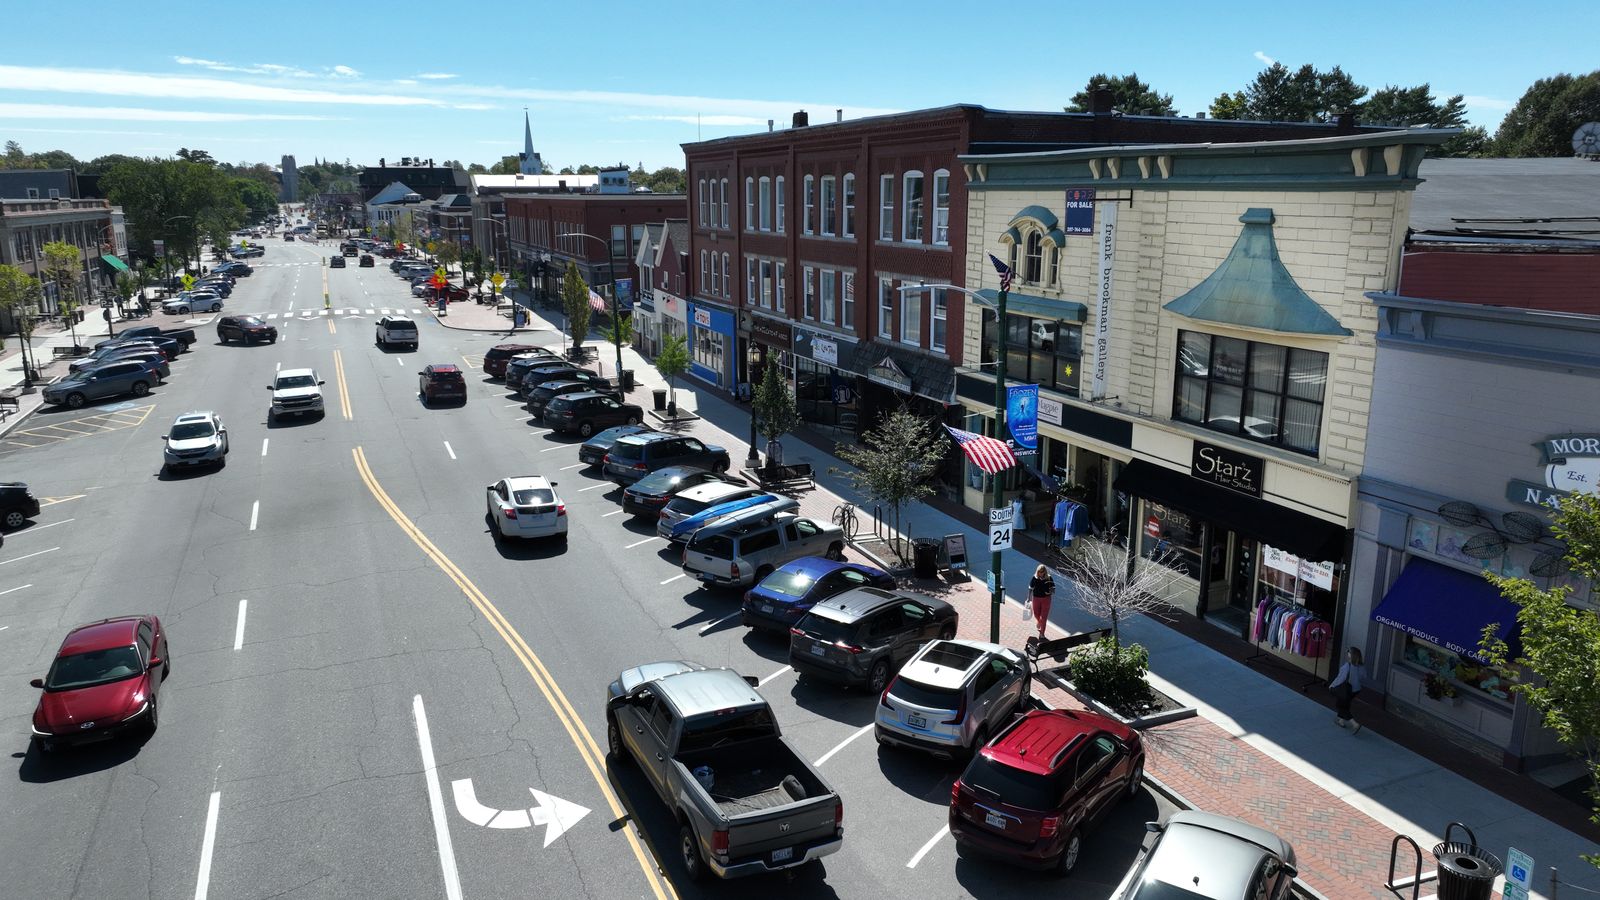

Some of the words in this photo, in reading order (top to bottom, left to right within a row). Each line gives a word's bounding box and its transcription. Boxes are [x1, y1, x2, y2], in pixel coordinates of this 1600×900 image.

[1067, 201, 1078, 209] FOR
[1078, 201, 1093, 209] SALE
[1104, 223, 1114, 261] frank
[1101, 268, 1112, 333] brockman
[1095, 338, 1107, 381] gallery
[1009, 388, 1037, 398] FROZEN
[1215, 472, 1231, 484] Hair
[1231, 479, 1257, 492] Studio
[1567, 470, 1588, 483] Est.
[991, 509, 1012, 521] SOUTH
[993, 529, 1010, 545] 24
[1375, 615, 1406, 631] ORGANIC
[1407, 626, 1439, 643] PRODUCE
[1445, 641, 1466, 654] BODY
[1467, 650, 1486, 662] CARE
[1504, 885, 1511, 896] 2
